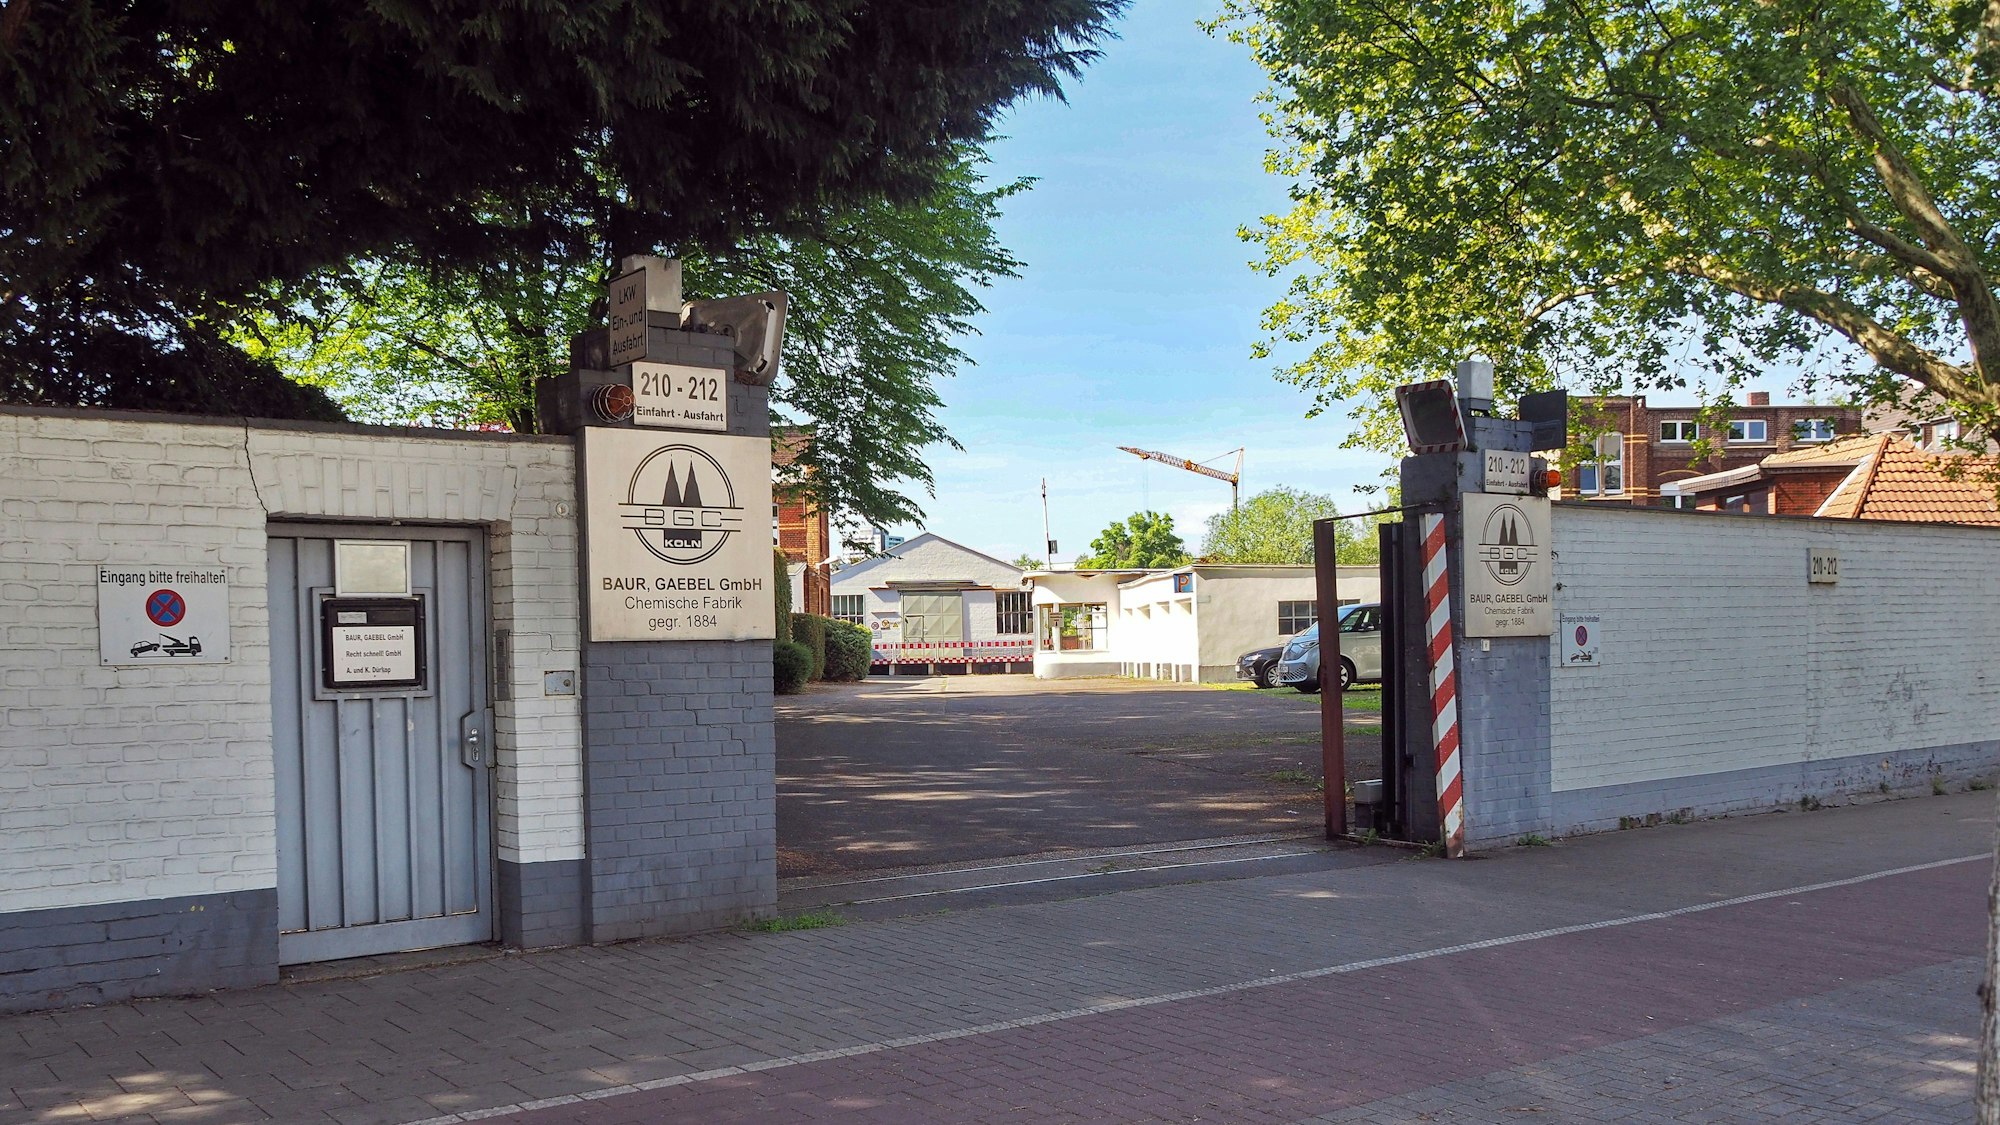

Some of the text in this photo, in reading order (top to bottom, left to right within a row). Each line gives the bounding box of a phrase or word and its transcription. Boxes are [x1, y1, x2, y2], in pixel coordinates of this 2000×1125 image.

[618, 283, 637, 305] LKW
[628, 306, 643, 326] und
[612, 331, 644, 356] Ausfahrt
[640, 371, 671, 398] 210
[688, 376, 718, 402] 212
[636, 405, 675, 419] Einfahrt
[683, 409, 724, 422] Ausfahrt
[1488, 455, 1503, 473] 210
[1510, 458, 1525, 475] 212
[1486, 479, 1505, 487] Einfahrt
[1508, 480, 1528, 488] Ausfahrt
[644, 508, 722, 527] BGC
[1489, 547, 1527, 560] BGC
[100, 570, 226, 587] Eingang bitte freihalten
[602, 577, 762, 593] BAUR, GAEBEL GmbH
[1178, 574, 1190, 593] P
[624, 596, 743, 610] Chemische Fabrik
[1470, 593, 1548, 604] BAUR, GAEBEL GmbH
[1484, 606, 1535, 615] Chemische Fabrik
[648, 615, 718, 631] gegr. 1884
[1494, 618, 1510, 628] gegr.
[345, 634, 363, 642] BAUR,
[387, 633, 404, 641] GmbH
